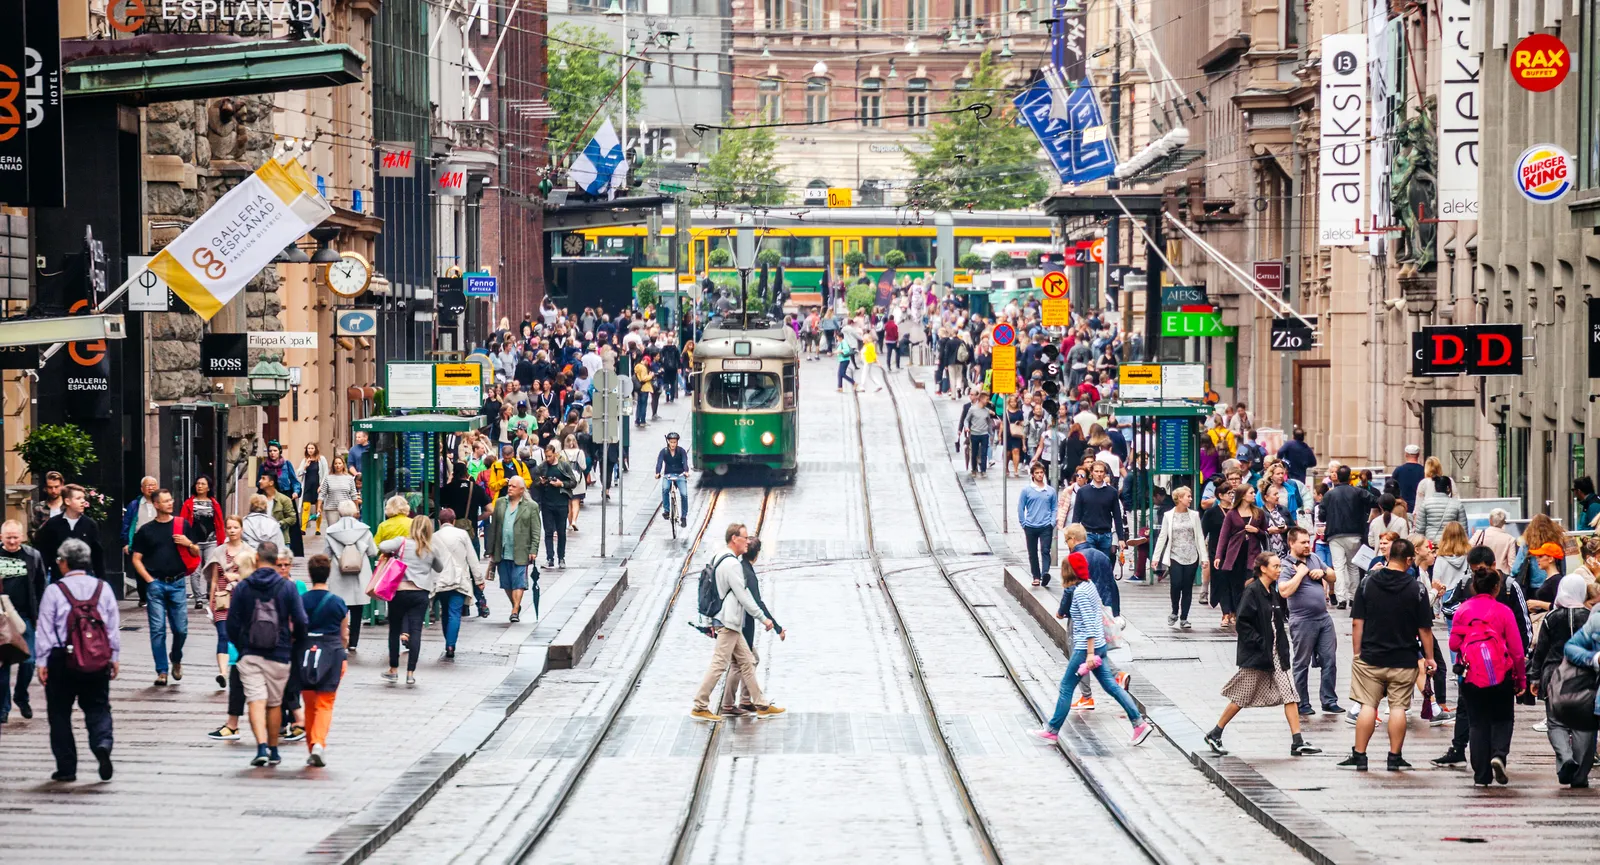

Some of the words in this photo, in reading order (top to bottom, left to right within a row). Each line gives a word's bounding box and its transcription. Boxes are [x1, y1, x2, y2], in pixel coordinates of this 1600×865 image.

[162, 0, 316, 21] ESPLANAD
[1516, 49, 1564, 68] RAX
[49, 70, 58, 105] HOTEL
[1322, 82, 1362, 205] aleksi
[382, 149, 413, 169] H&M
[1523, 156, 1565, 178] BURGER
[438, 171, 463, 188] H&M
[1525, 165, 1567, 191] KING
[828, 193, 837, 206] 10
[211, 194, 267, 248] GALLERIA
[219, 202, 275, 257] ESPLANAD
[257, 212, 283, 239] DISTRICT
[1322, 227, 1354, 240] aleksi
[229, 239, 256, 264] FASHION
[469, 279, 495, 287] Fenno
[249, 335, 278, 346] Filippa
[279, 335, 287, 345] K
[1272, 330, 1303, 348] Zio
[210, 358, 242, 368] BOSS
[1047, 363, 1058, 375] S
[67, 377, 108, 385] GALLERIA
